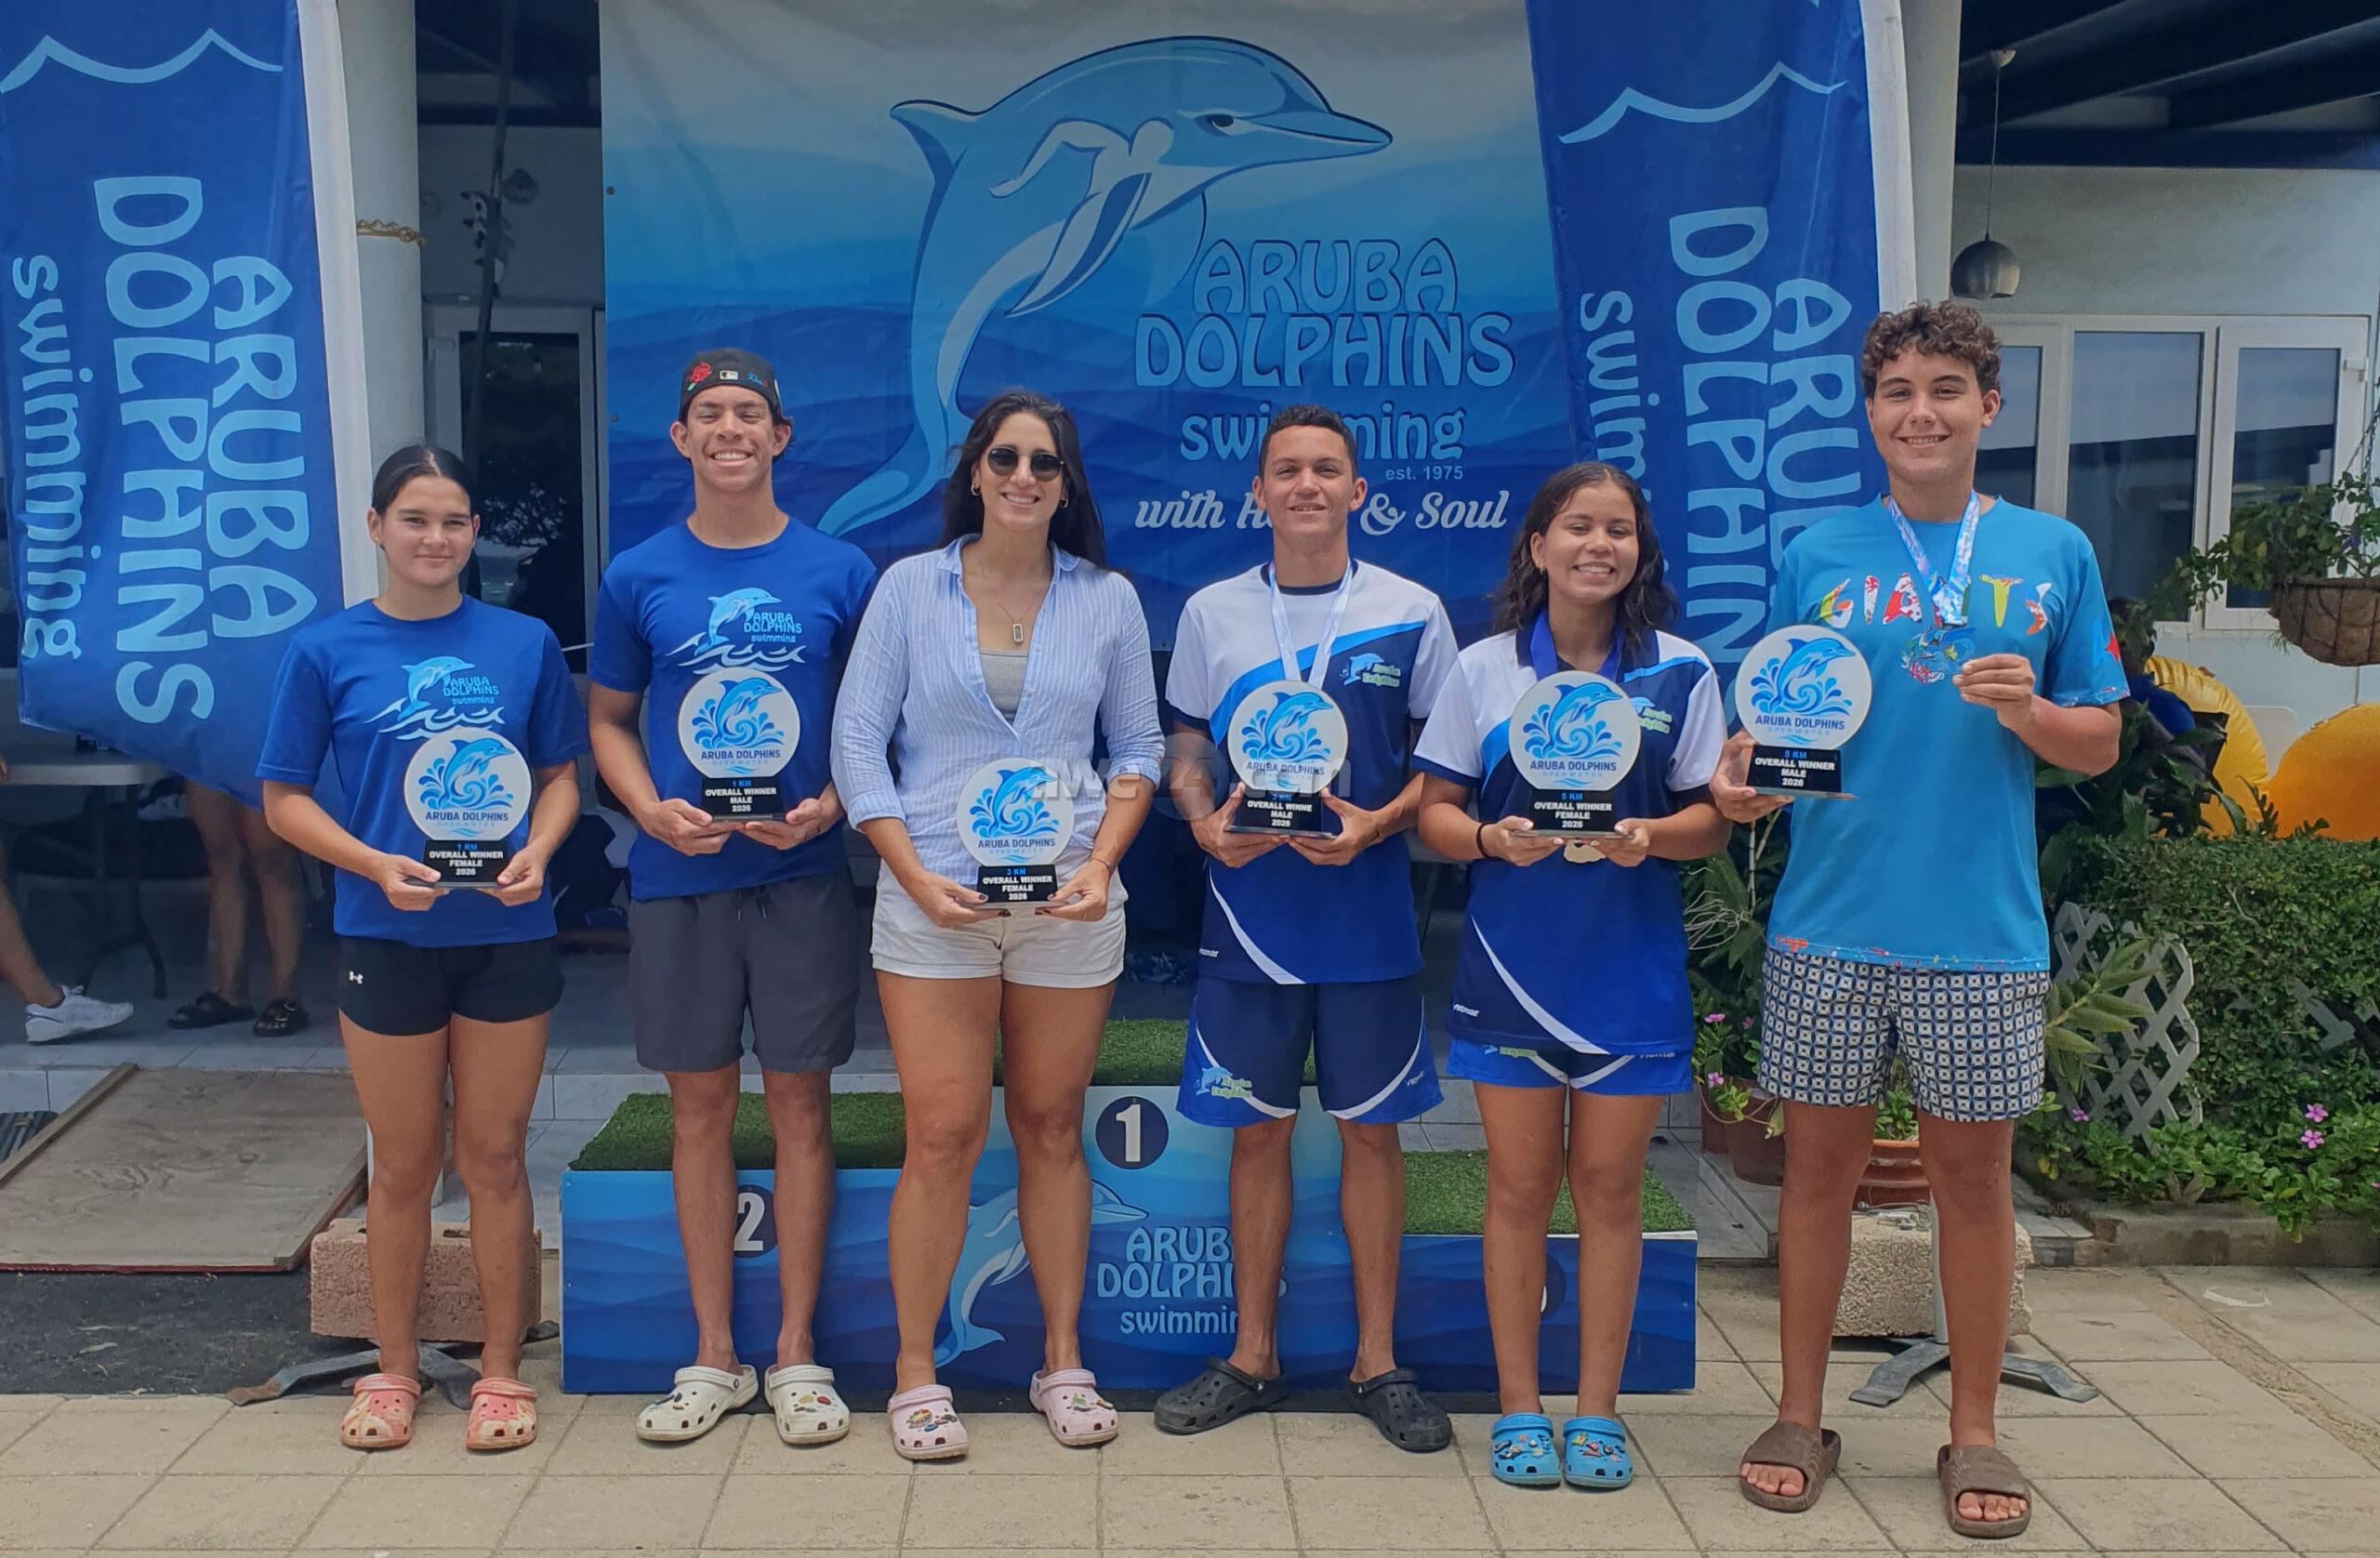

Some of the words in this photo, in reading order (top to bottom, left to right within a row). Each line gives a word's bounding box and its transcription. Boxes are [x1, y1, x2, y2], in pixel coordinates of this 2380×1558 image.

[1193, 237, 1458, 313] ARUBA
[1134, 312, 1516, 388] DOLPHINS
[1180, 400, 1466, 461] swiming
[93, 176, 215, 723] DOLPHINS
[203, 256, 317, 640] ARUBA
[12, 255, 101, 660] swimming
[1385, 466, 1416, 481] est.
[1423, 466, 1463, 481] 1975
[1669, 206, 1772, 728] DOLPHIN
[1134, 490, 1226, 529] with
[1359, 492, 1407, 536] &
[1414, 490, 1510, 530] Soul
[753, 613, 794, 624] ARUBA
[744, 623, 802, 634] DOLPHINS
[450, 676, 490, 686] ARUBA
[443, 685, 499, 696] DOLPHINS
[1755, 714, 1792, 727] ARUBA
[1794, 718, 1844, 730] DOLPHINS
[701, 750, 734, 759] ARUBA
[736, 749, 781, 759] DOLPHINS
[1246, 761, 1278, 772] ARUBA
[1281, 764, 1325, 775] DOLPHINS
[1530, 761, 1565, 770] ARUBA
[1568, 761, 1617, 772] DOLPHINS
[1754, 757, 1796, 768] OVERALL
[1798, 760, 1835, 771] WINNER
[1781, 768, 1806, 778] MALE
[1248, 800, 1284, 810] OVERALL
[1534, 802, 1574, 811] OVERALL
[425, 812, 459, 821] ARUBA
[463, 812, 509, 822] DOLPHINS
[1271, 811, 1293, 819] MALE
[978, 839, 1010, 848] ARUBA
[1012, 838, 1056, 848] DOLPHINS
[1116, 1102, 1143, 1163] 1
[734, 1192, 766, 1251] 2
[1126, 1226, 1235, 1262] ARUB
[1097, 1261, 1288, 1299] DOLPHI
[1120, 1304, 1239, 1334] swimmi
